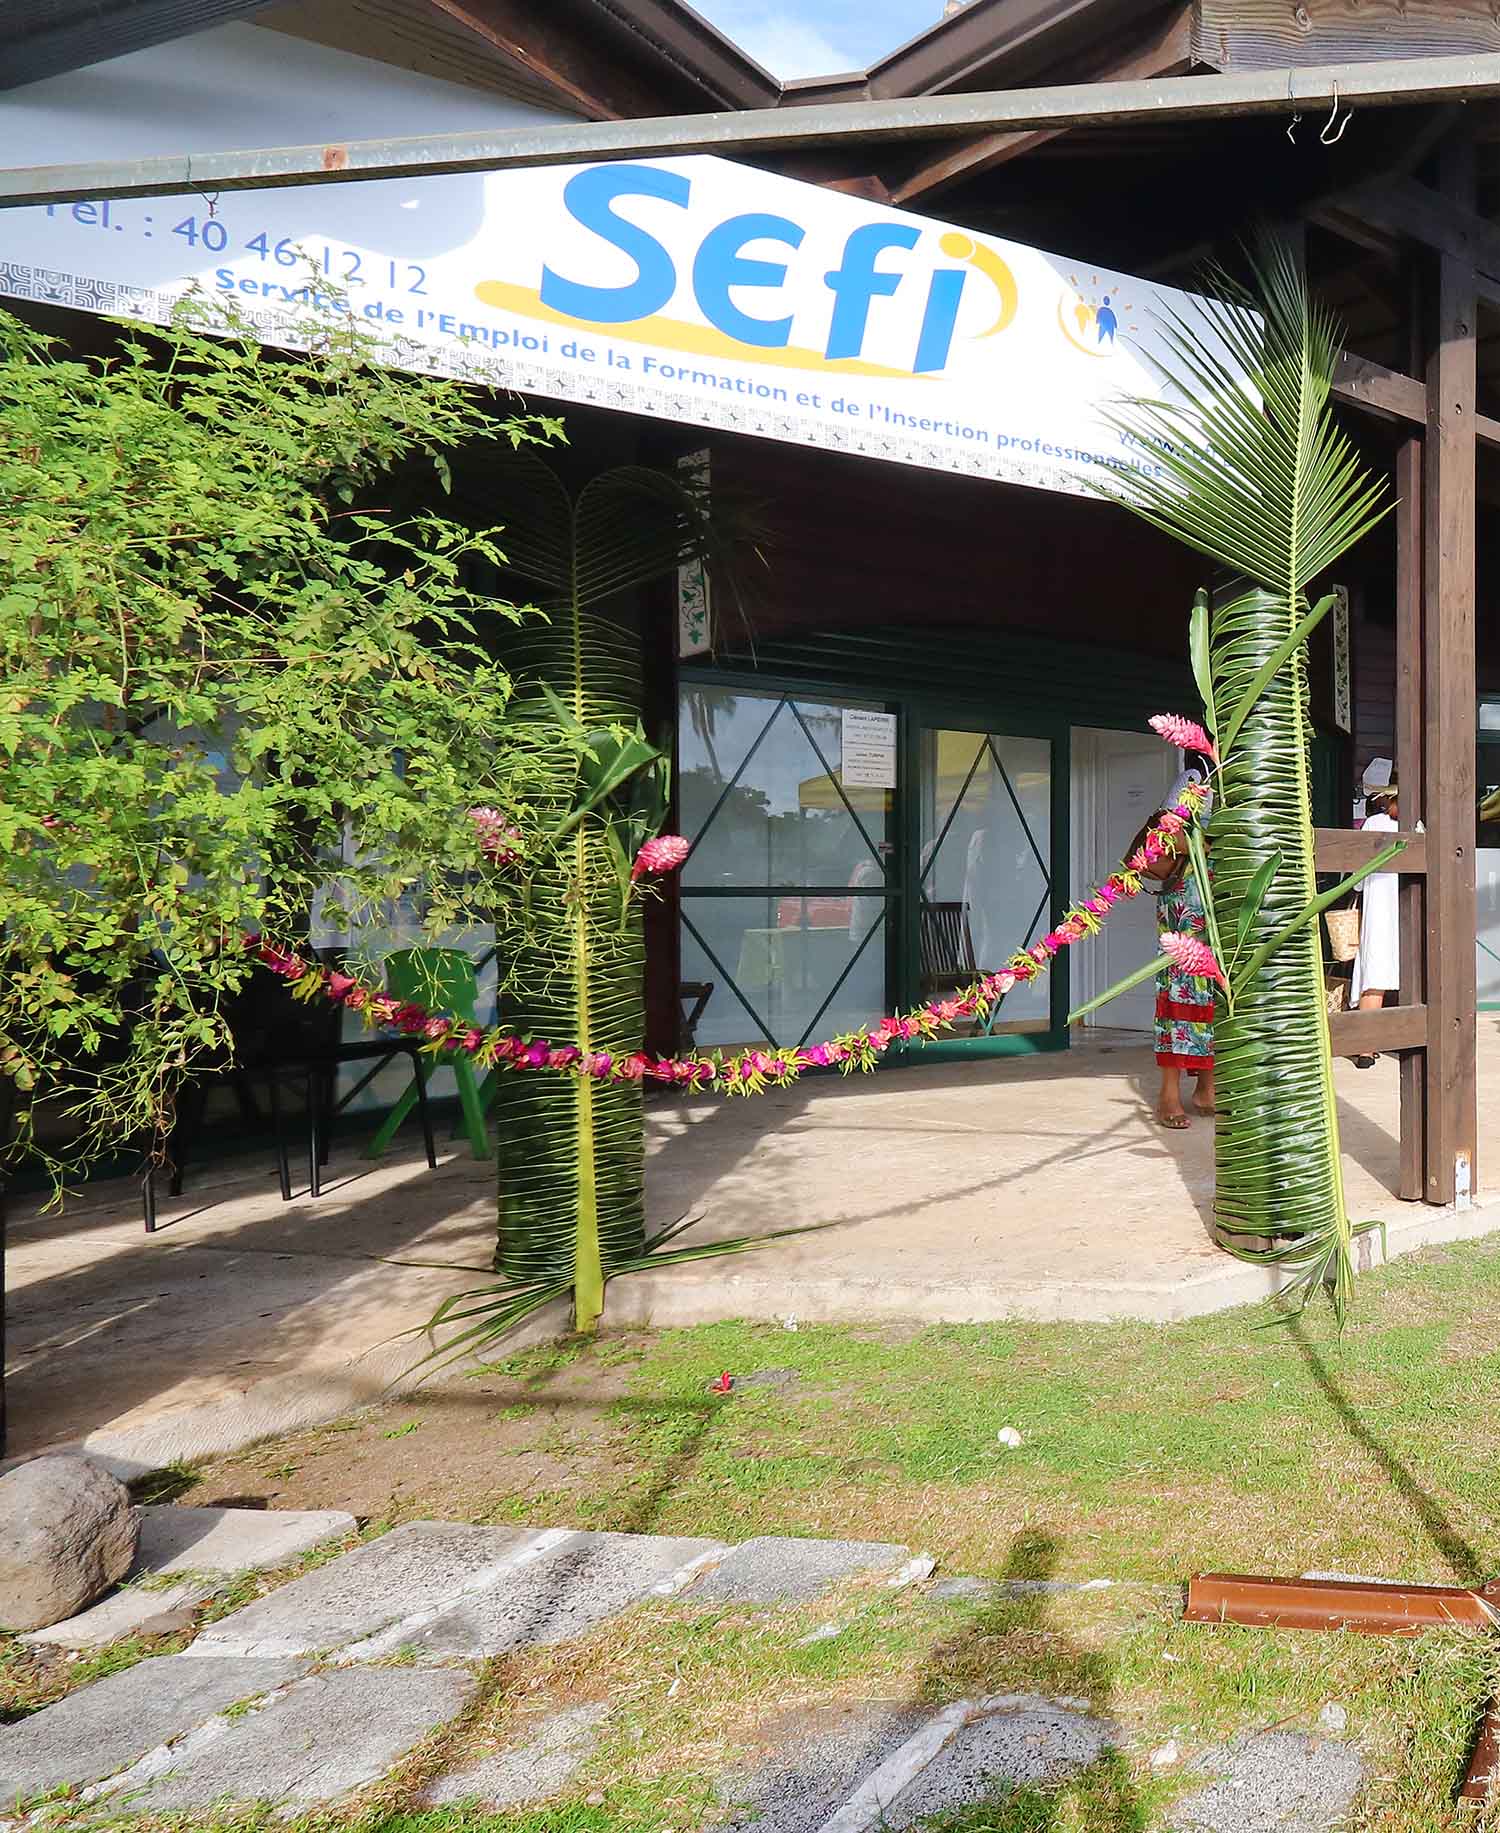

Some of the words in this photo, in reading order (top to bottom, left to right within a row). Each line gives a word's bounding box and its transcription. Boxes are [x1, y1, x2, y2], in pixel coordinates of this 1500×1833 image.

[172, 216, 228, 252] 40
[245, 231, 297, 266] 46
[324, 246, 364, 282] 12
[390, 260, 428, 295] 12
[540, 164, 980, 374] Sefi
[215, 268, 350, 313] Service
[363, 301, 404, 324] de
[417, 309, 549, 352] l'Emploi
[560, 341, 596, 362] de
[608, 349, 631, 369] la
[642, 356, 788, 402] Formation
[796, 391, 821, 408] et
[831, 397, 860, 416] de
[869, 402, 989, 443] l'Insertion
